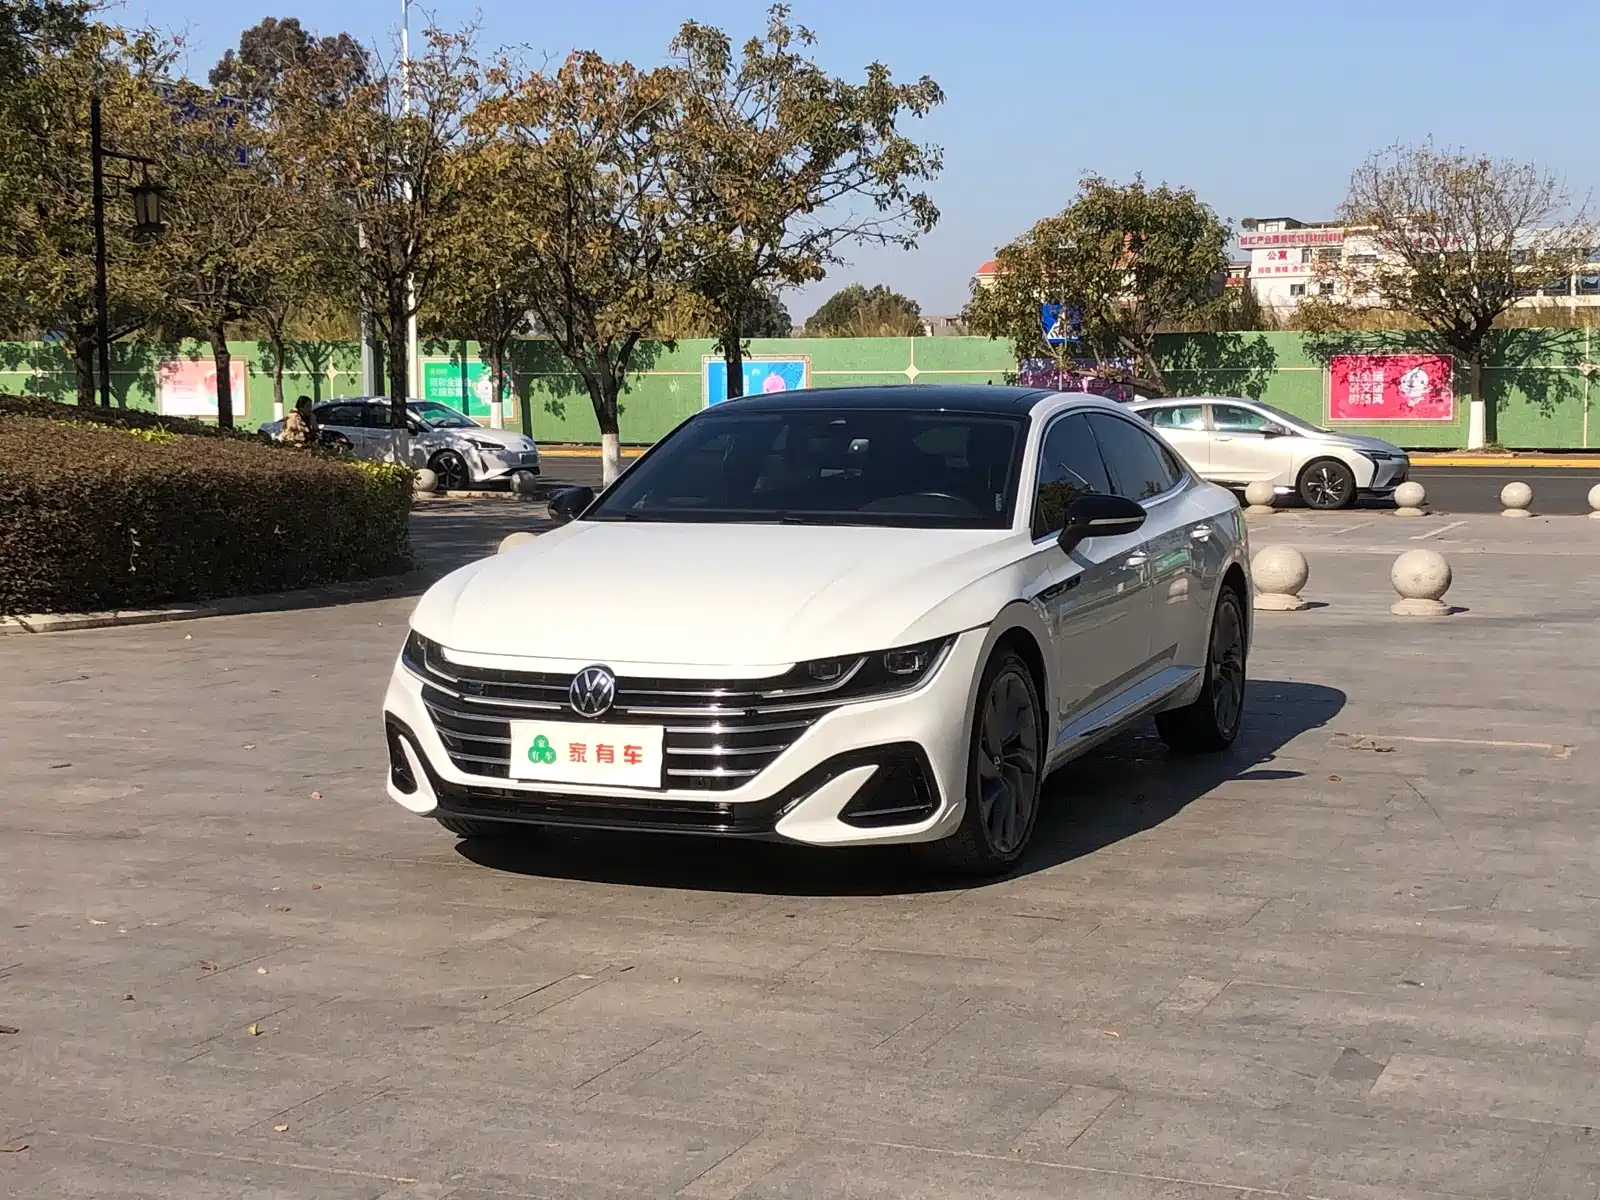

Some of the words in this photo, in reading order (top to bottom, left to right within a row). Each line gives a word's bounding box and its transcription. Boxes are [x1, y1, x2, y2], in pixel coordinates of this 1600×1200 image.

[1267, 250, 1288, 260] 公寓
[569, 743, 643, 765] 家有车
